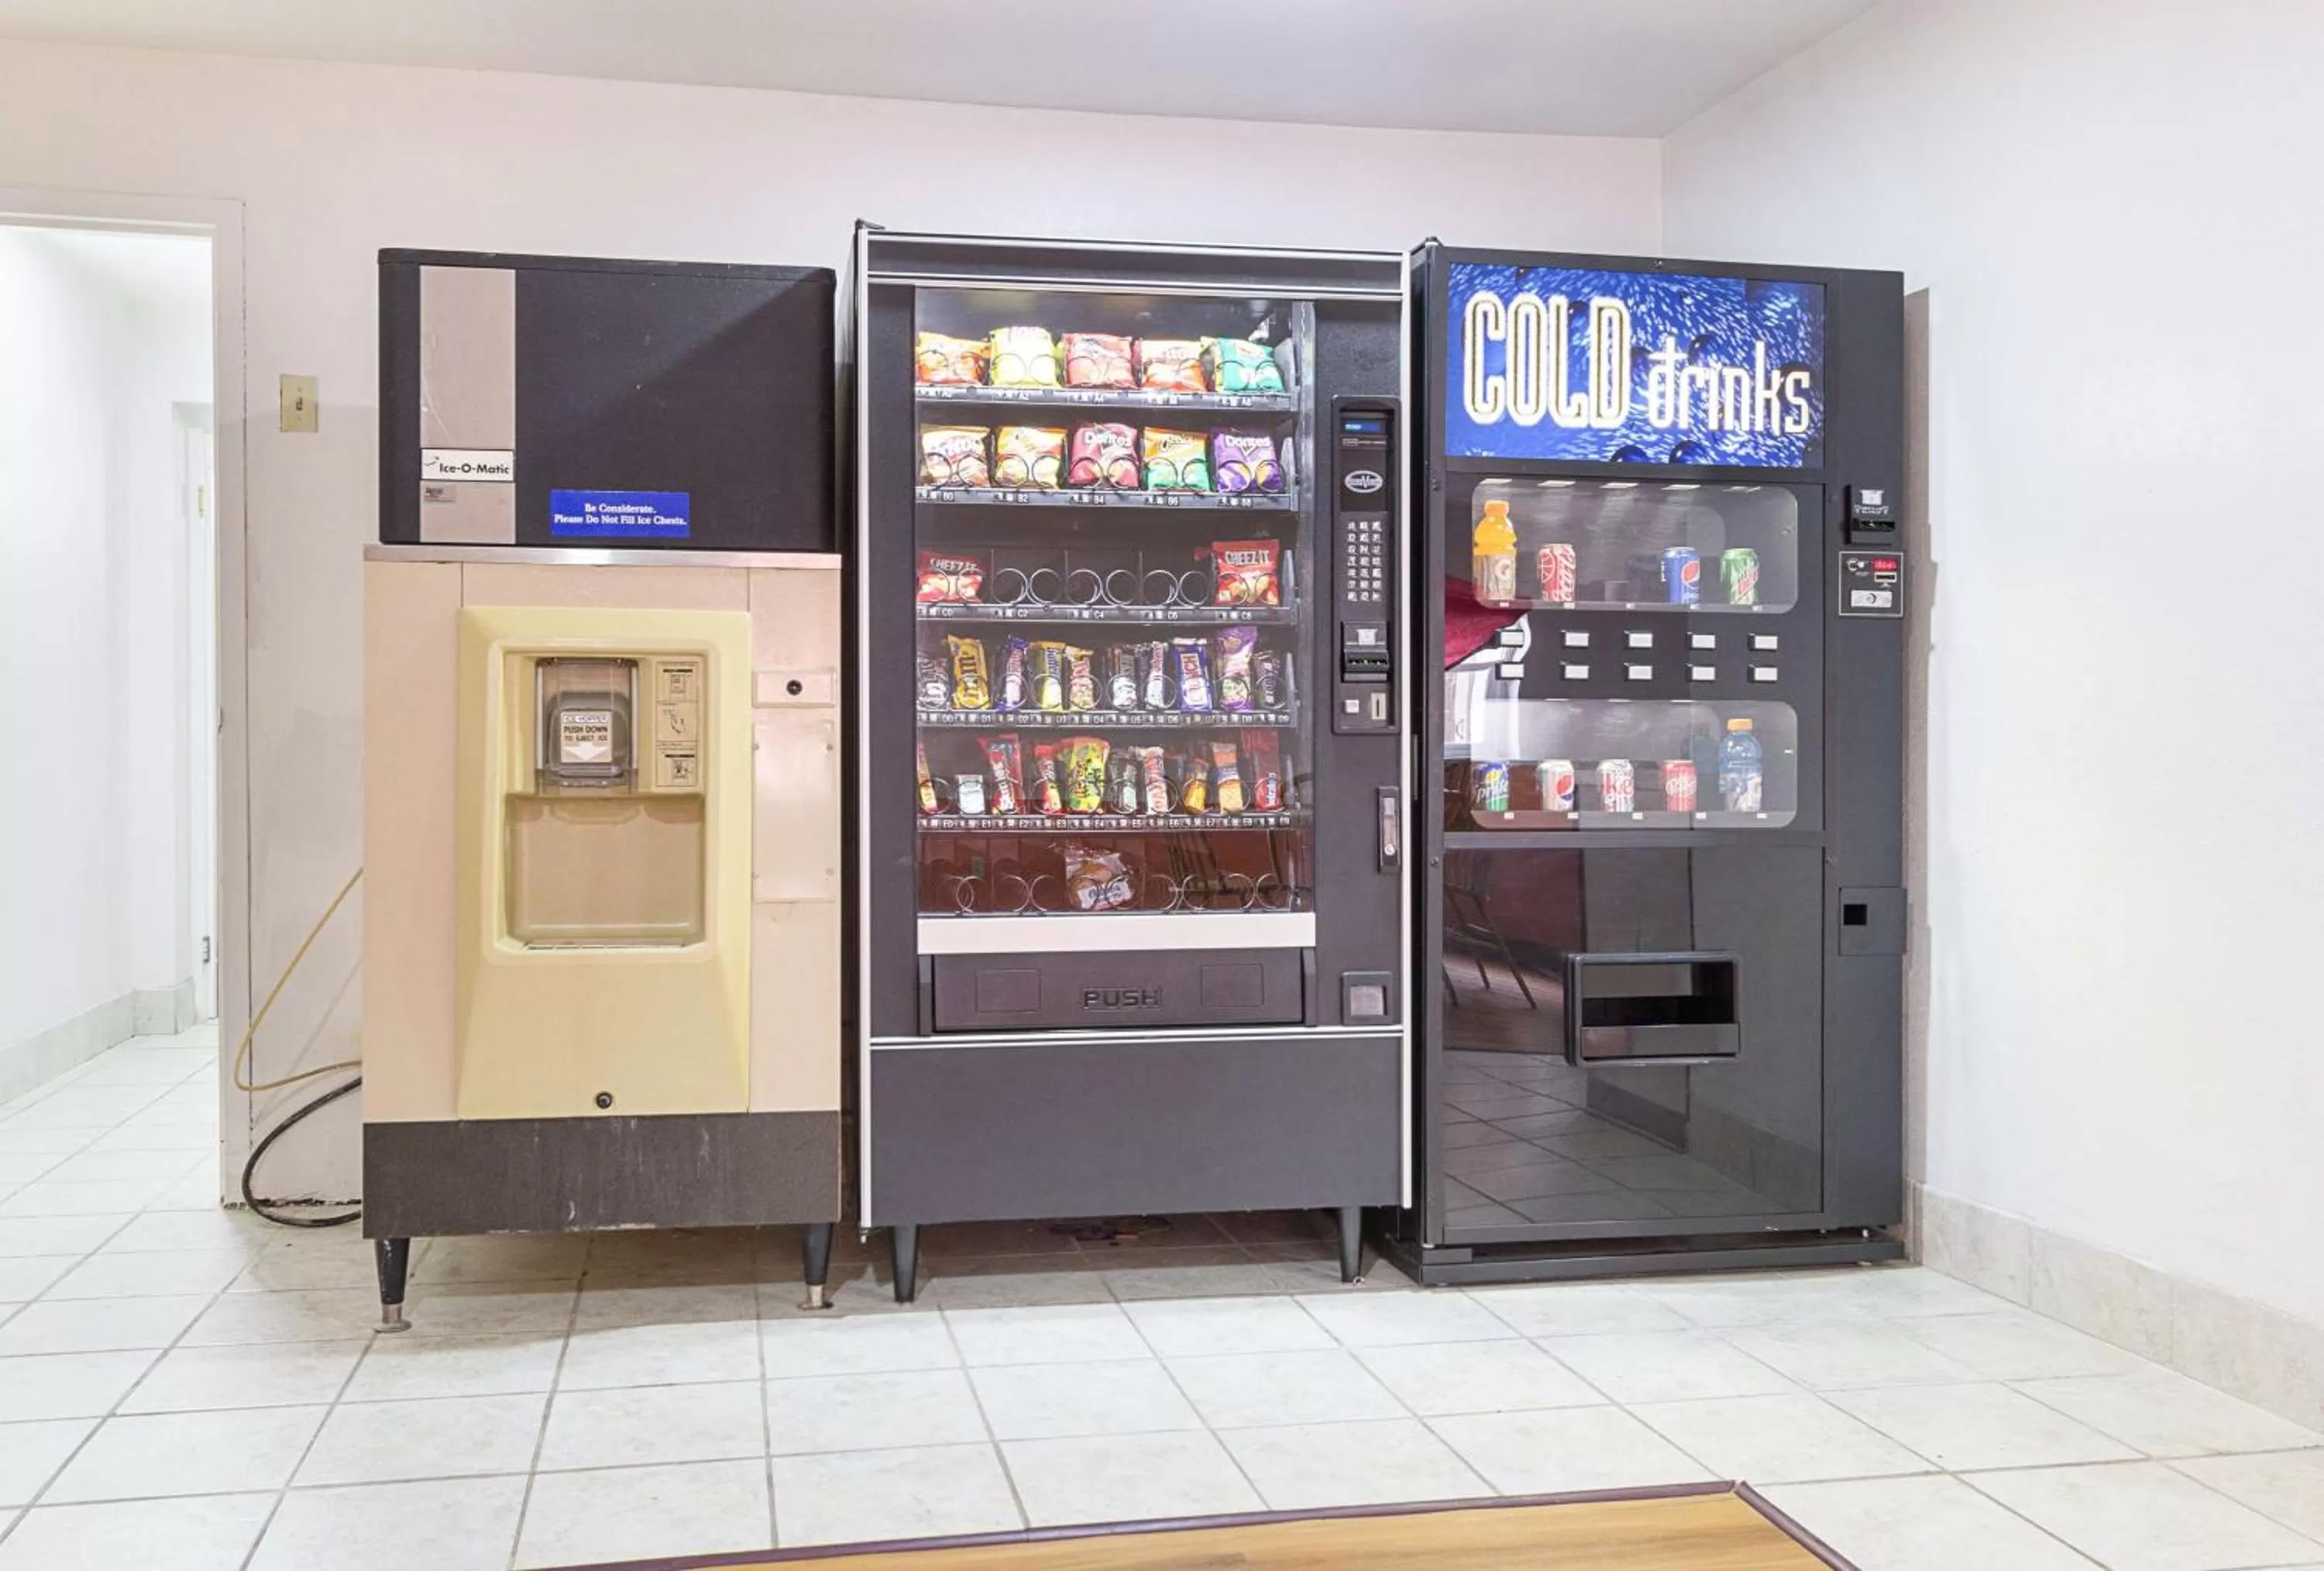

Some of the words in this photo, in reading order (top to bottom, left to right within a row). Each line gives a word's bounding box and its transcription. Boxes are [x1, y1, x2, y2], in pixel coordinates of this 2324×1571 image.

[1463, 290, 1630, 428] COLD
[1647, 334, 1810, 435] drinks
[439, 462, 509, 474] Ice-O-Matic
[584, 503, 596, 513] Be
[599, 503, 657, 514] Considerate.
[554, 514, 583, 524] Please
[586, 514, 599, 524] Do
[601, 514, 618, 524] Not
[621, 515, 635, 524] Fill
[638, 515, 651, 524] Ice
[653, 515, 687, 525] Chests.
[563, 725, 583, 734] PUSH
[585, 725, 608, 734] DOWN
[1085, 990, 1161, 1007] PUSH
